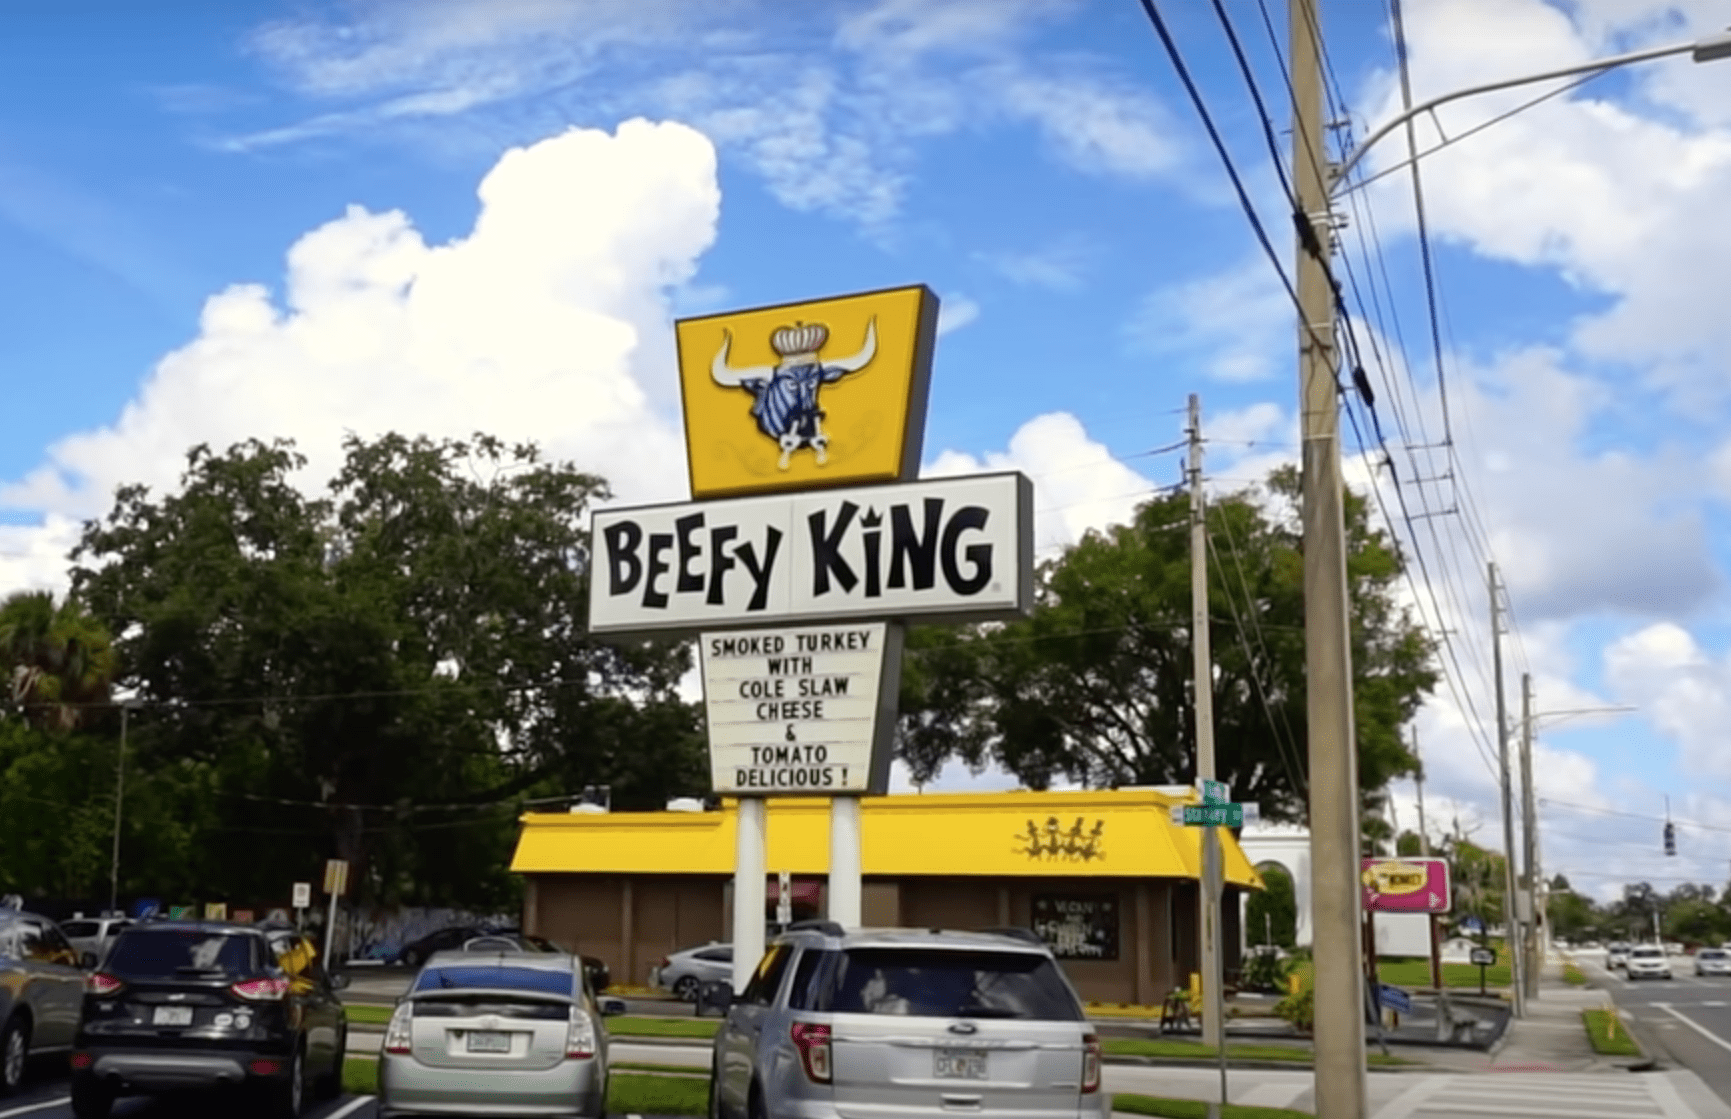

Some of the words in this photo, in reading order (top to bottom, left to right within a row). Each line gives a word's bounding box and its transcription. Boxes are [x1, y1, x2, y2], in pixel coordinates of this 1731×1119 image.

[603, 512, 783, 611] BEEFY
[711, 636, 785, 657] SMOKED
[795, 631, 870, 650] TURKEY
[767, 656, 812, 676] WITH
[739, 679, 784, 700] COLE
[798, 677, 849, 698] SLAW
[756, 700, 823, 721] CHEESE
[785, 723, 797, 742] &
[751, 744, 828, 765] TOMATO
